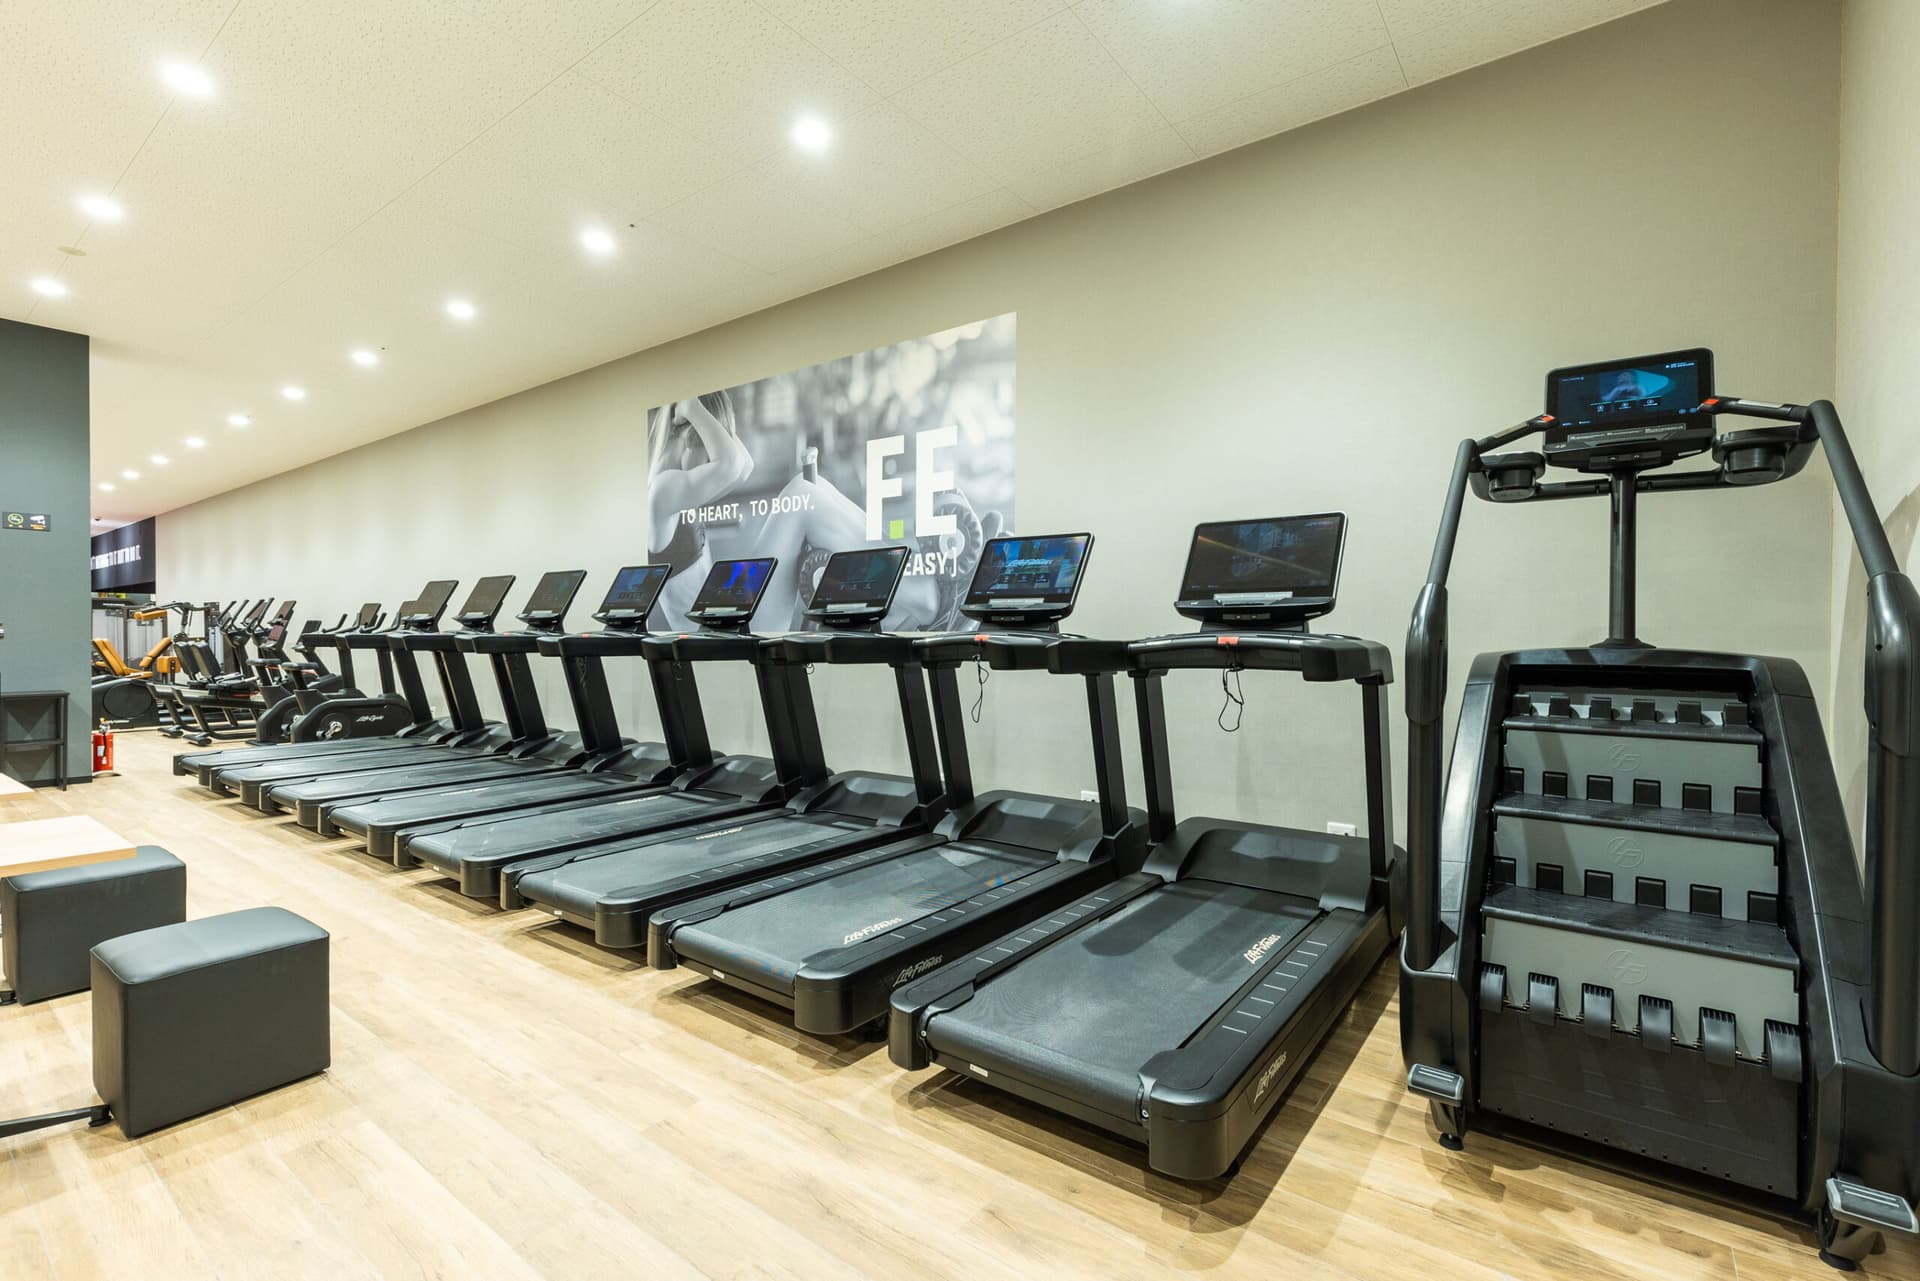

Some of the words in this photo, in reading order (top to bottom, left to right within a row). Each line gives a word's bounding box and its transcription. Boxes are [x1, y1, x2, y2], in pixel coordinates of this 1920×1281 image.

[680, 508, 696, 525] TO
[698, 503, 743, 523] HEART,
[750, 499, 768, 517] TO
[771, 494, 815, 514] BODY.
